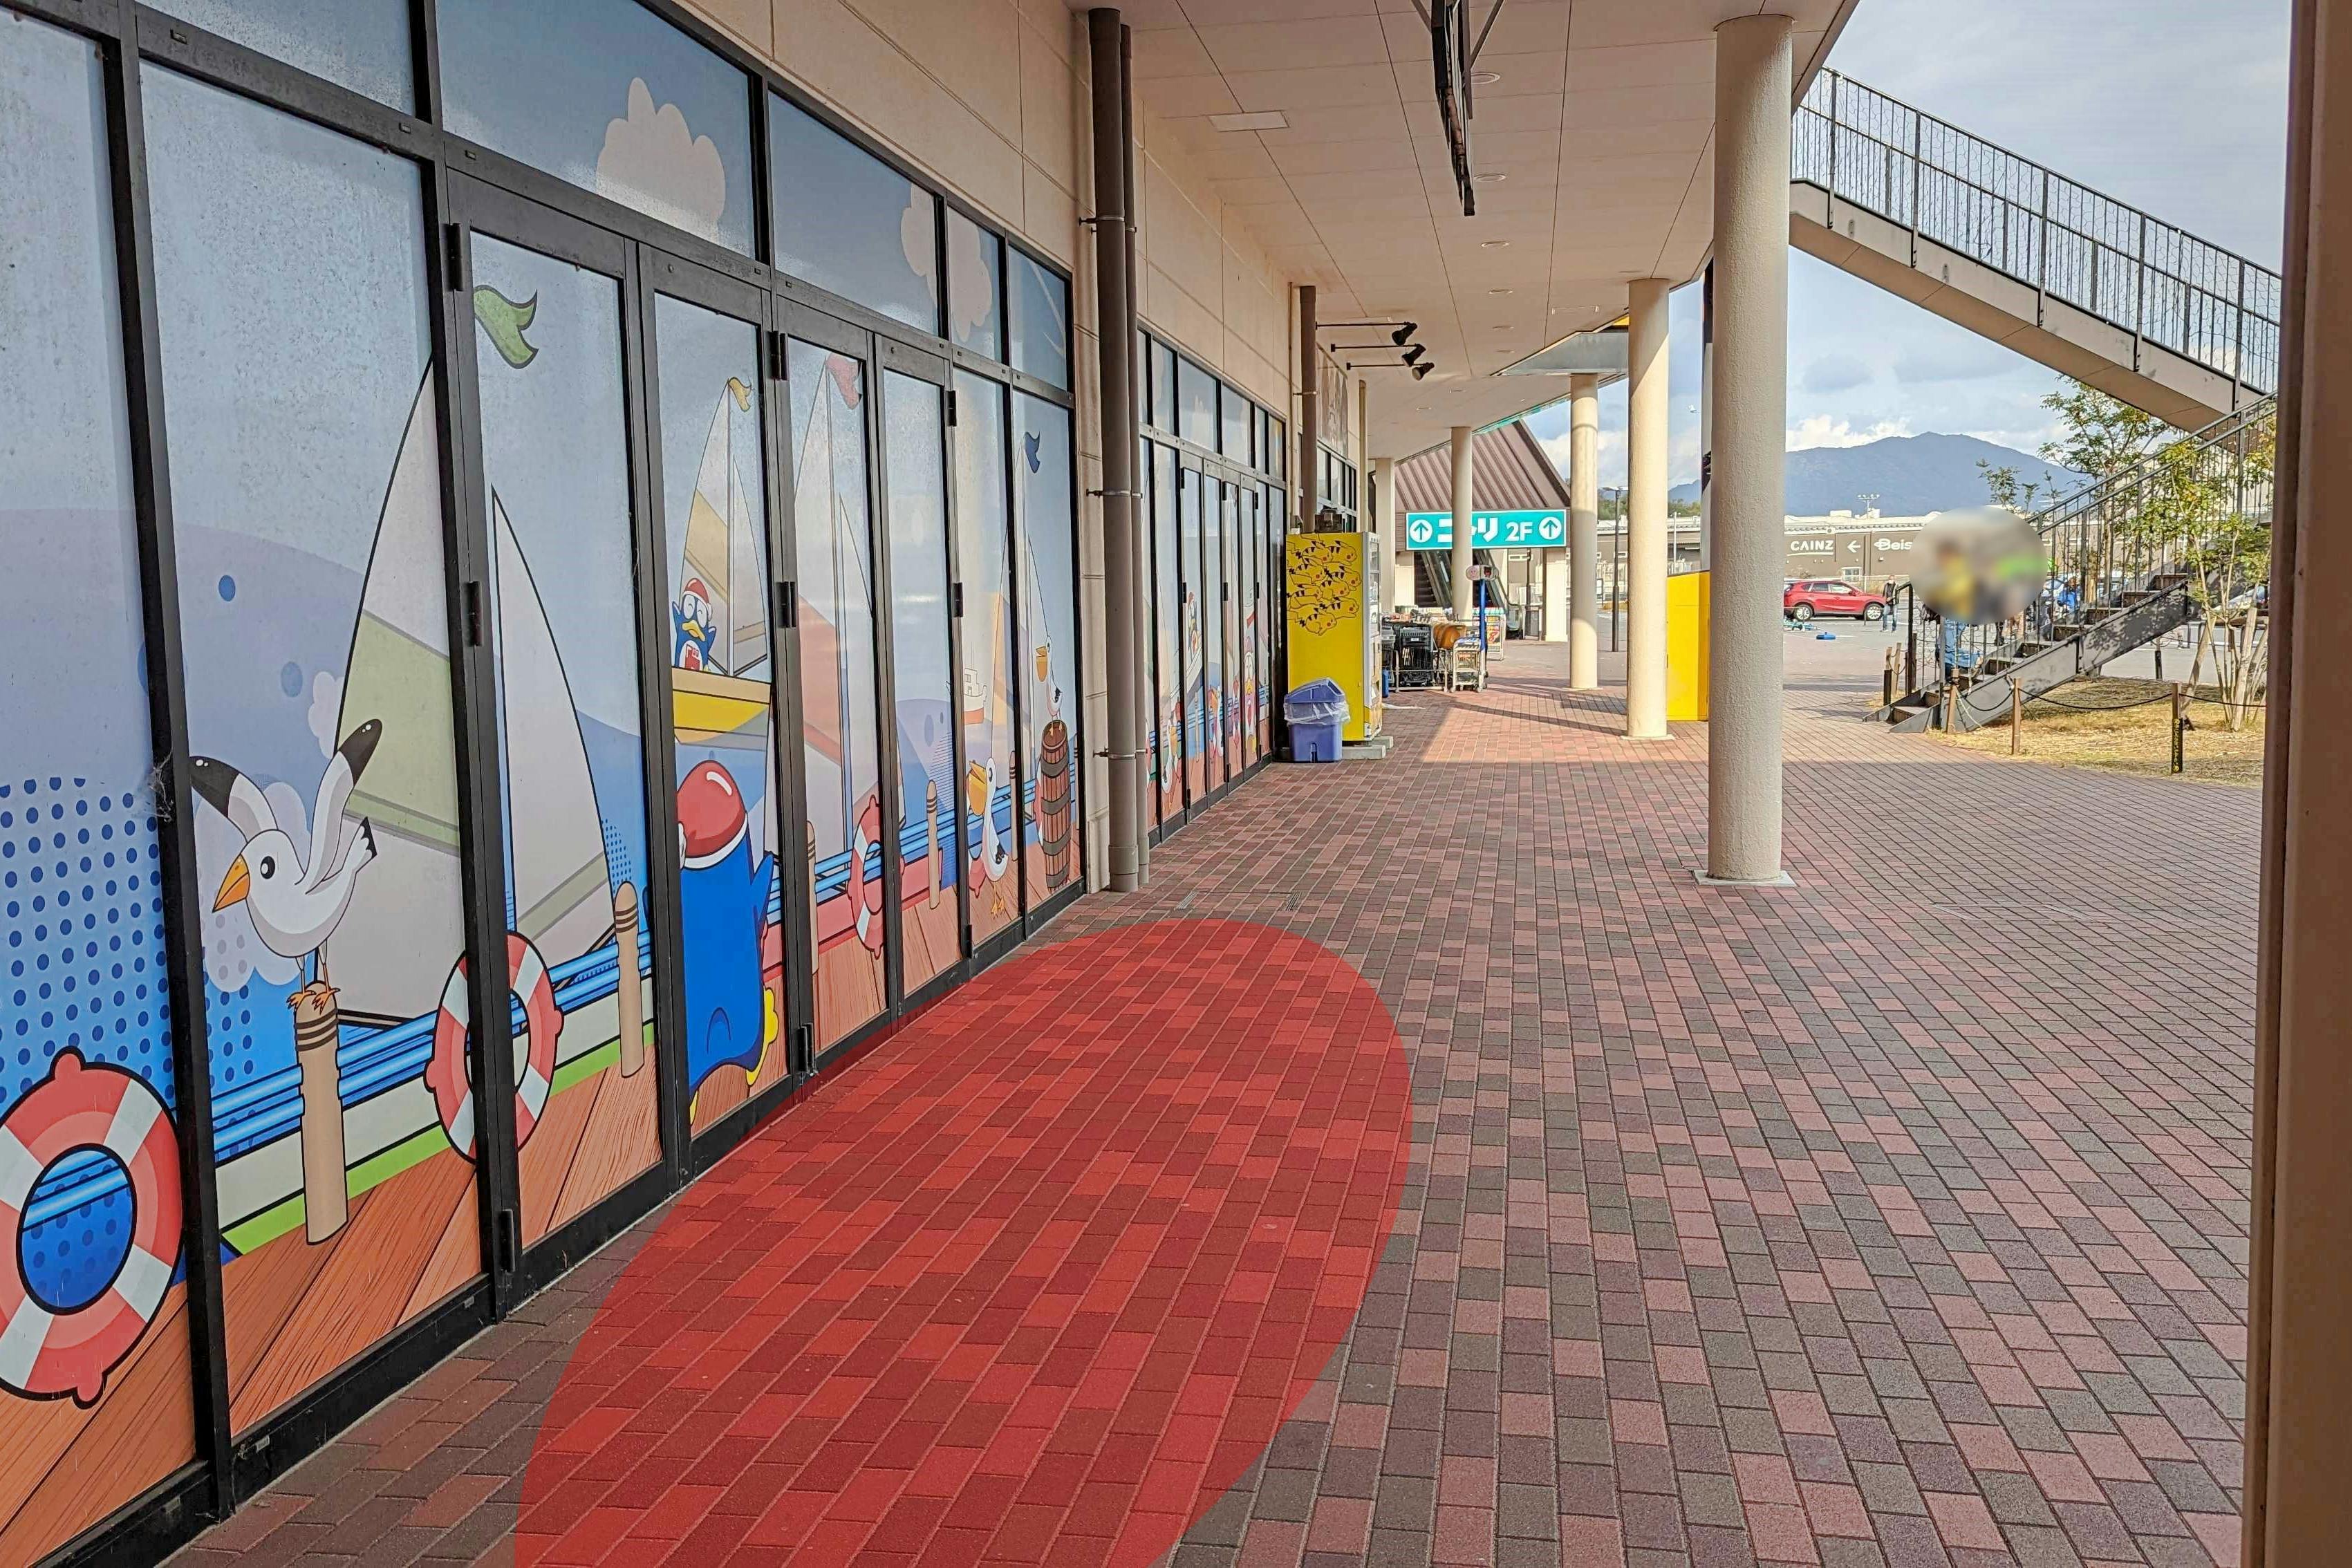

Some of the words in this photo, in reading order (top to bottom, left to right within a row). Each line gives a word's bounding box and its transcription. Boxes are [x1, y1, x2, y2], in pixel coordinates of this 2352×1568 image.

[1437, 518, 1498, 542] ニリ
[1505, 521, 1533, 541] 2F
[1790, 540, 1834, 551] CAINZ
